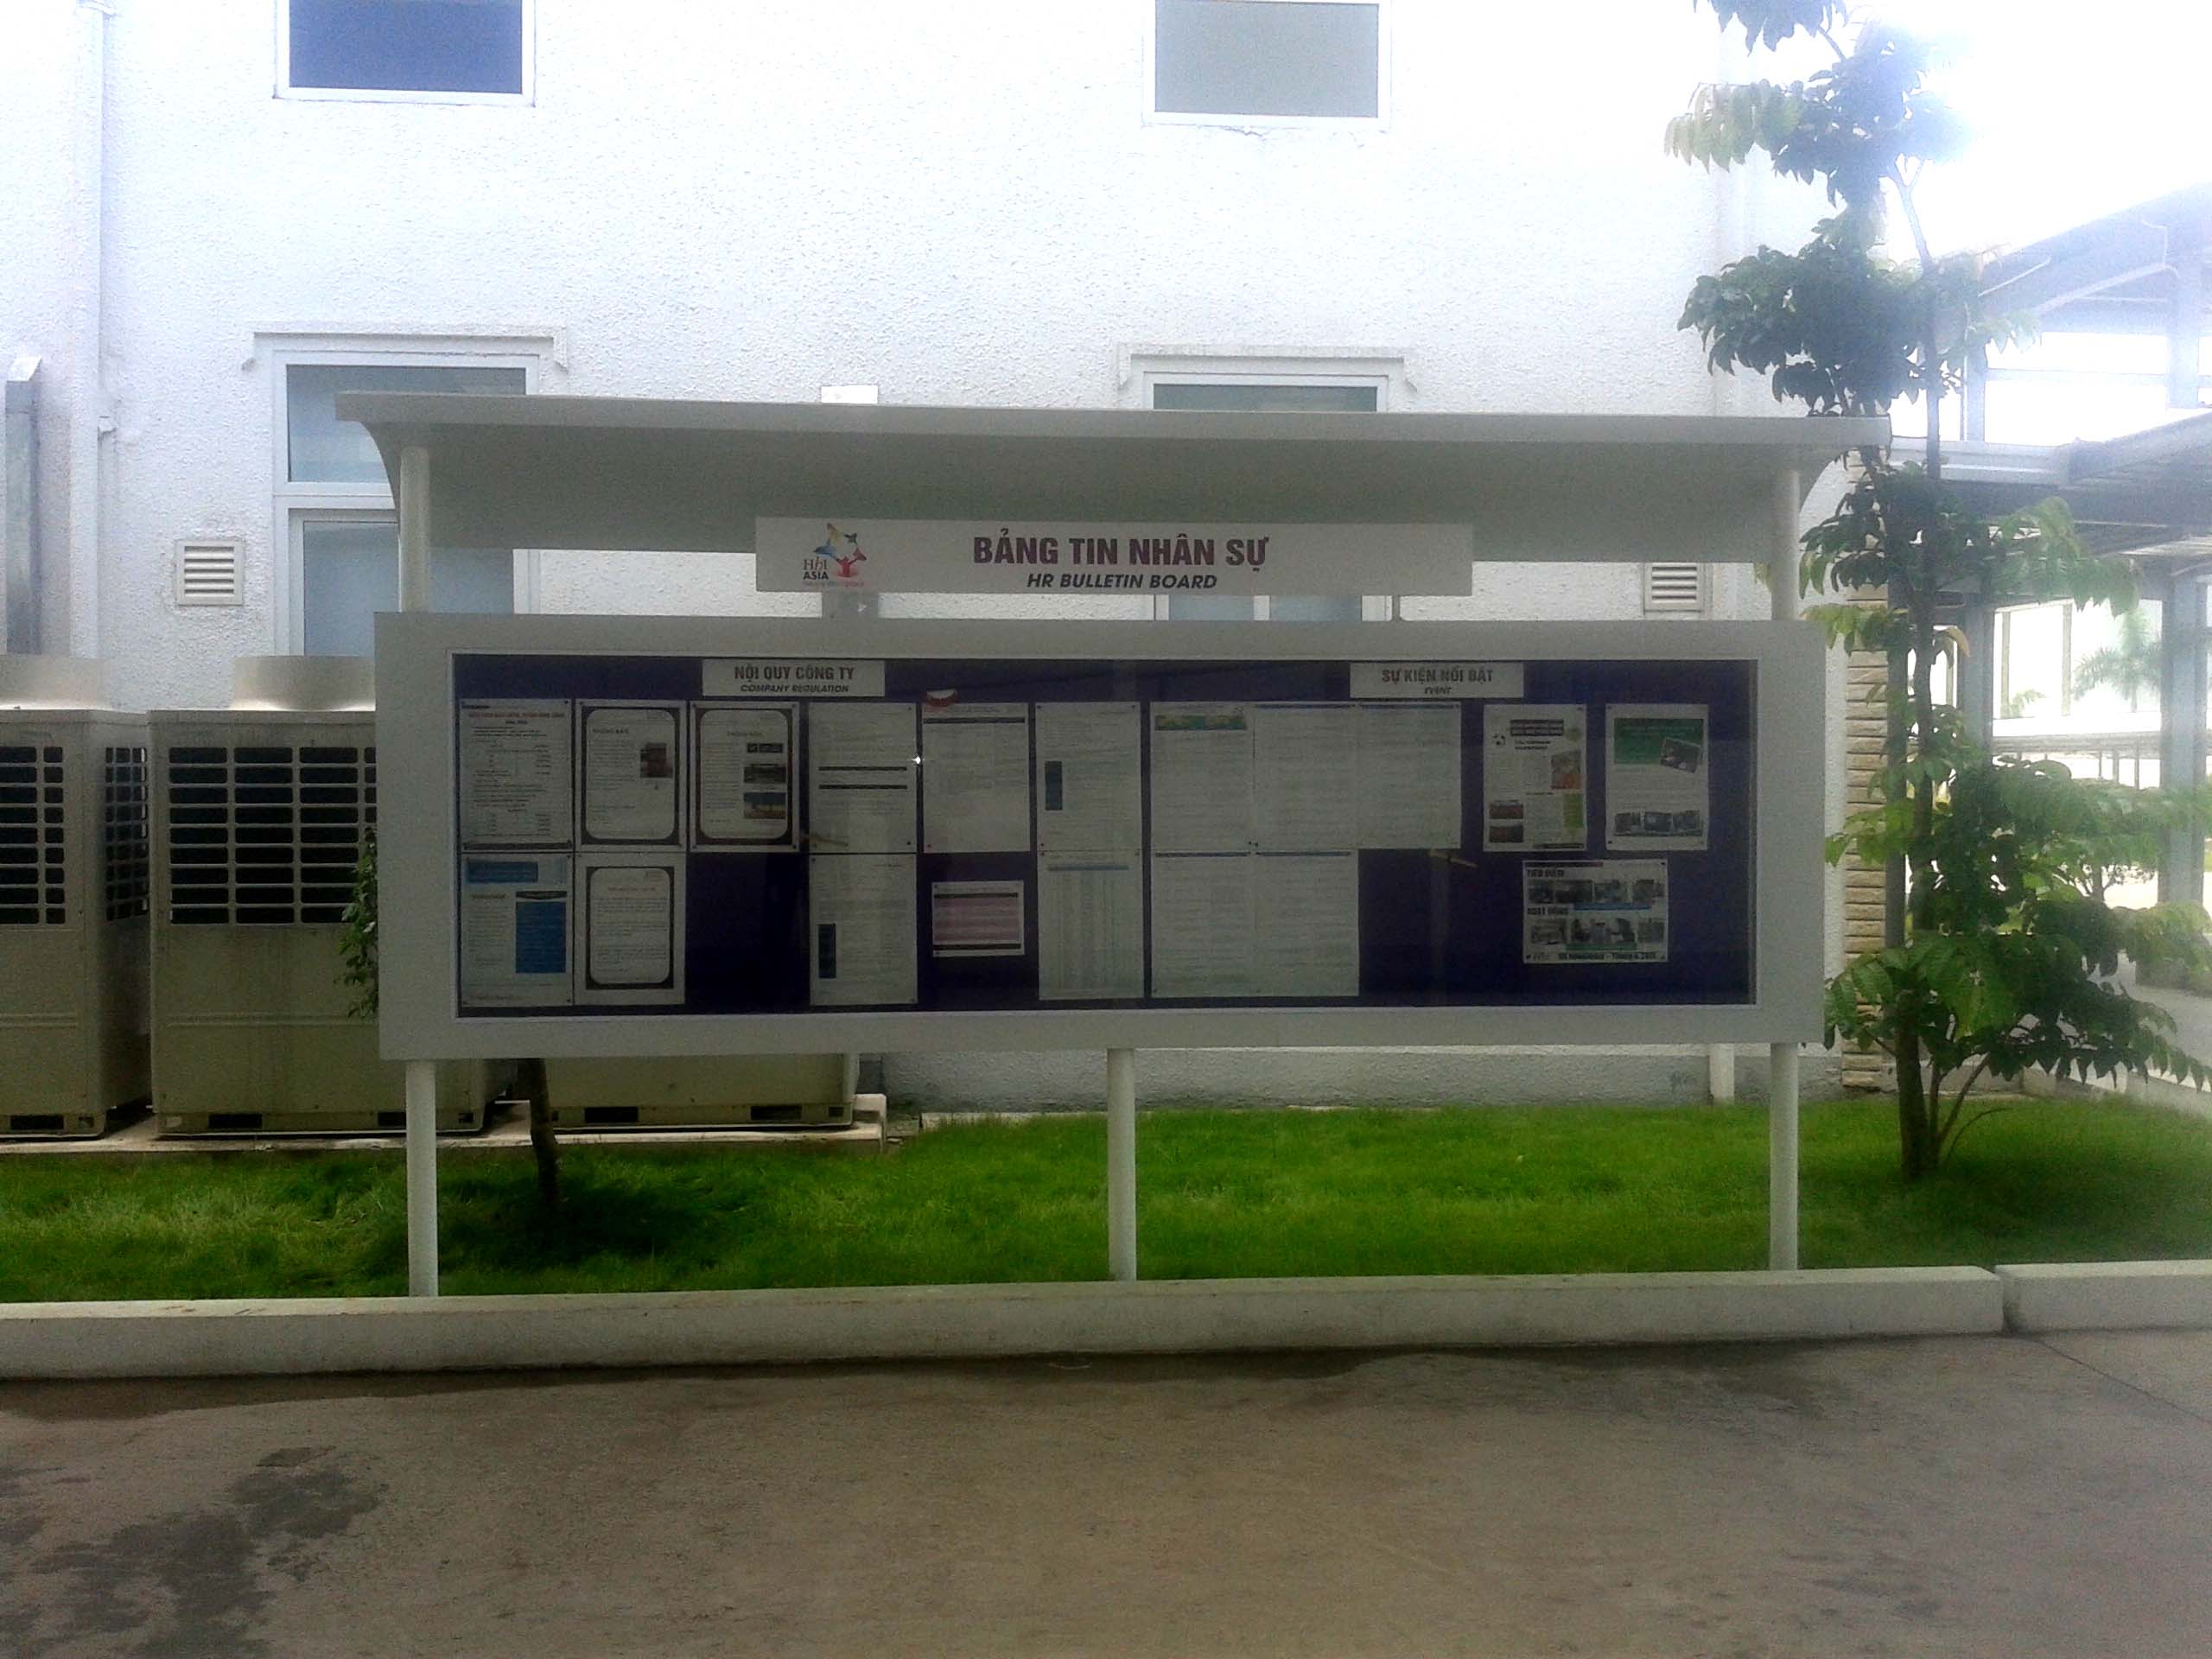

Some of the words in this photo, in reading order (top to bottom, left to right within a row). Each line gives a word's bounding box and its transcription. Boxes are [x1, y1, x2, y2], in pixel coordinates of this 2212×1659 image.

[973, 528, 1058, 564] BẢNG
[1069, 538, 1118, 565] TIN
[1128, 533, 1214, 566] NHÂN
[1225, 537, 1269, 572] SỰ
[803, 571, 830, 580] ASIA
[1027, 573, 1053, 588] HR
[1060, 574, 1142, 588] BULLETIN
[1149, 575, 1217, 589] BOARD
[796, 664, 836, 680] CÔNG
[839, 666, 855, 680] TY
[741, 683, 790, 692] COMPANY
[792, 684, 849, 693] REGULATION
